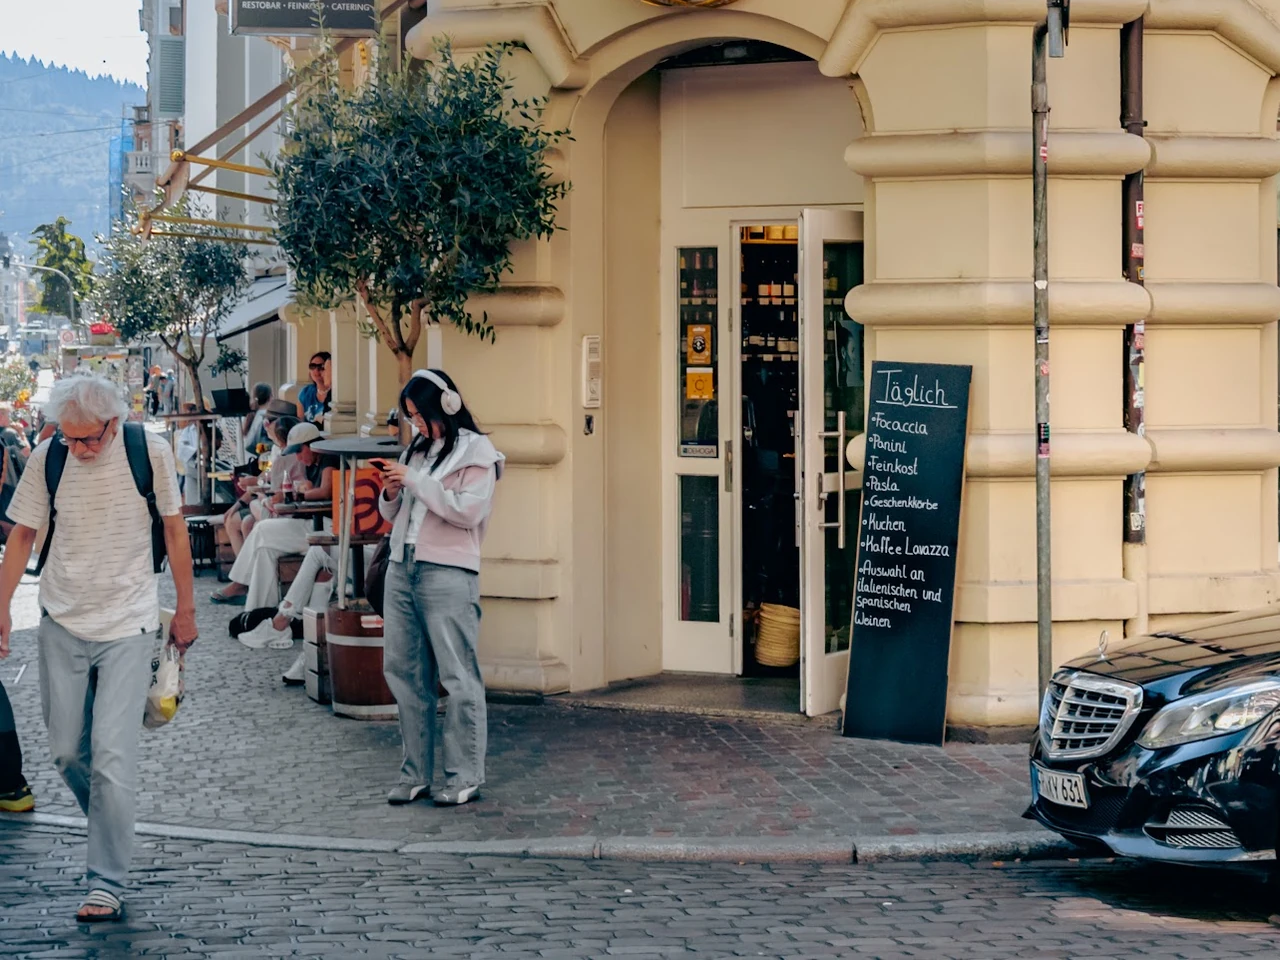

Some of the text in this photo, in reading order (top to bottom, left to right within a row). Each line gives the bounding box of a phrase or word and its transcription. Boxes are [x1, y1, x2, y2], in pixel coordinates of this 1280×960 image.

[242, 1, 281, 10] RESTOBAR
[331, 3, 370, 11] CATERING
[876, 369, 949, 408] Täglich
[875, 412, 928, 435] Focaccia
[872, 433, 907, 454] Panini
[870, 455, 918, 475] Feinkost
[869, 475, 900, 491] Pasta
[868, 512, 906, 532] Kuchen
[865, 534, 950, 557] Kaffee Lavazza
[862, 559, 925, 582] Auswahl an
[922, 588, 942, 603] und
[854, 610, 891, 628] Weinen
[1061, 778, 1084, 804] 631
